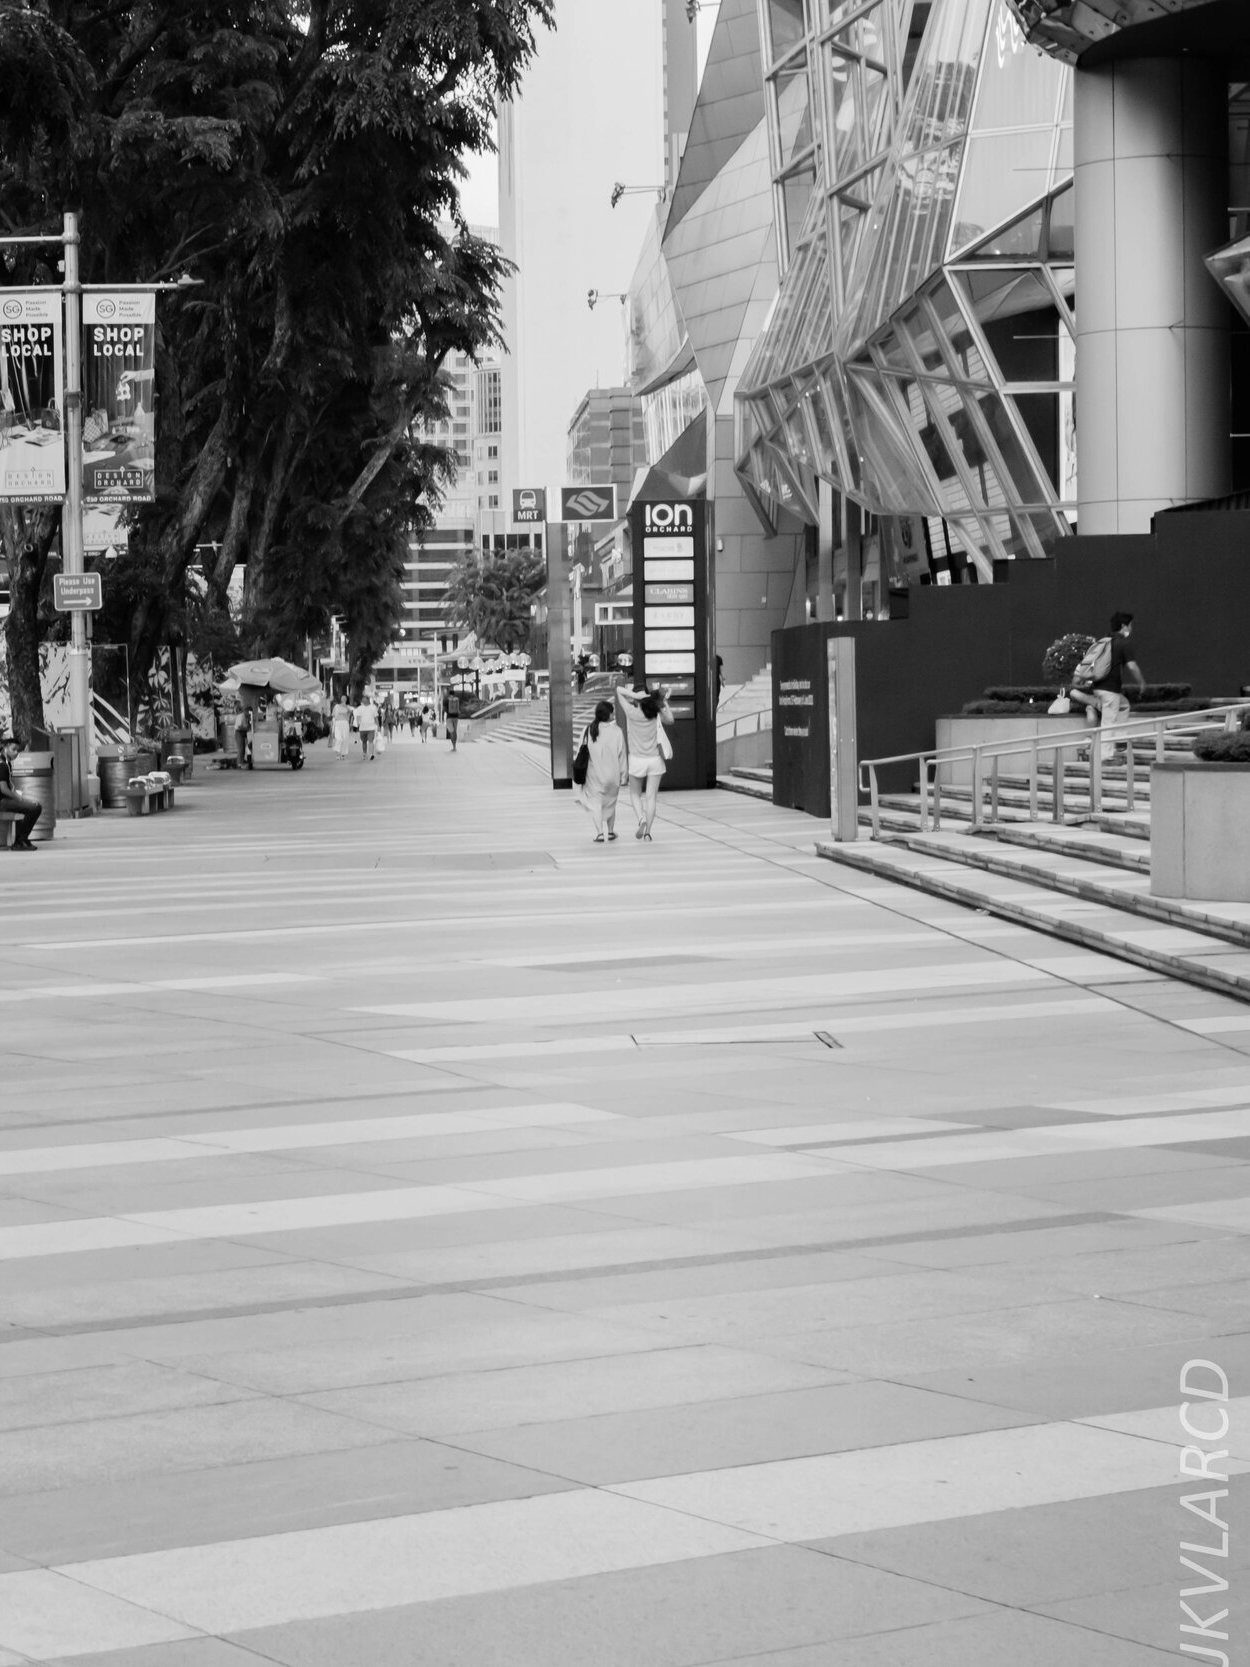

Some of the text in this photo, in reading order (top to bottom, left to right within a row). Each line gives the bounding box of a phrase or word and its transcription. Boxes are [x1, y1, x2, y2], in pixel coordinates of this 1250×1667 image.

[1, 327, 52, 342] SHOP
[93, 327, 145, 342] SHOP
[1, 344, 52, 357] LOCAL
[93, 344, 145, 357] LOCAL
[97, 471, 141, 480] DESIGN
[97, 479, 141, 487] ORCHARD
[99, 495, 132, 503] ORCHARD
[517, 510, 539, 520] MRT
[59, 576, 96, 586] Please Use
[60, 586, 95, 596] Underpass
